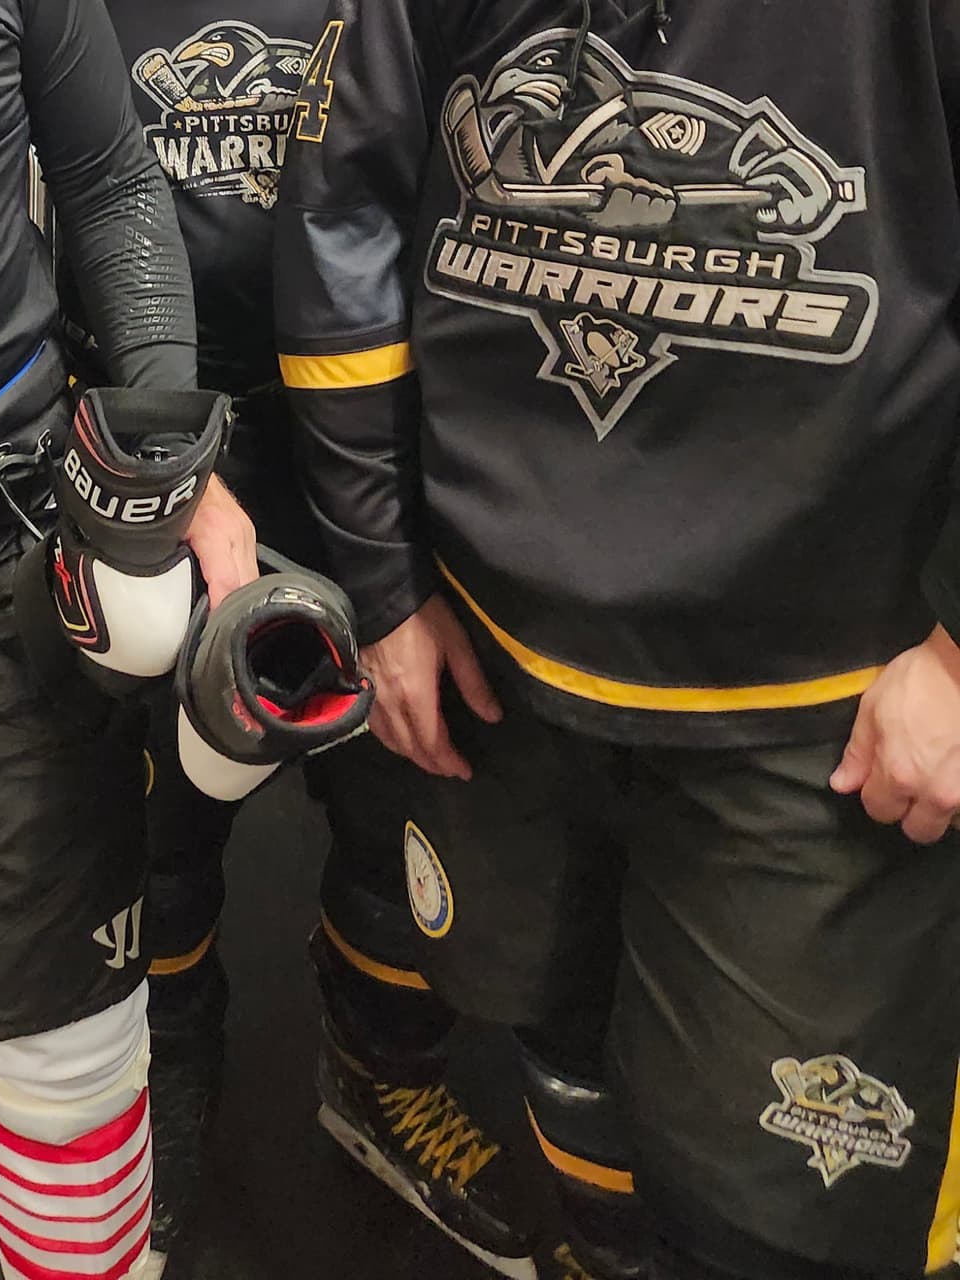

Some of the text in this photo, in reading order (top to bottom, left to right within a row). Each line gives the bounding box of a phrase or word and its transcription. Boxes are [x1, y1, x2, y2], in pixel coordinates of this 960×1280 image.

[471, 214, 785, 280] PITTSBURGH
[436, 238, 849, 338] WARRIORS
[773, 1111, 900, 1159] WARRIORS
[790, 1106, 890, 1143] PITTSBURGH
